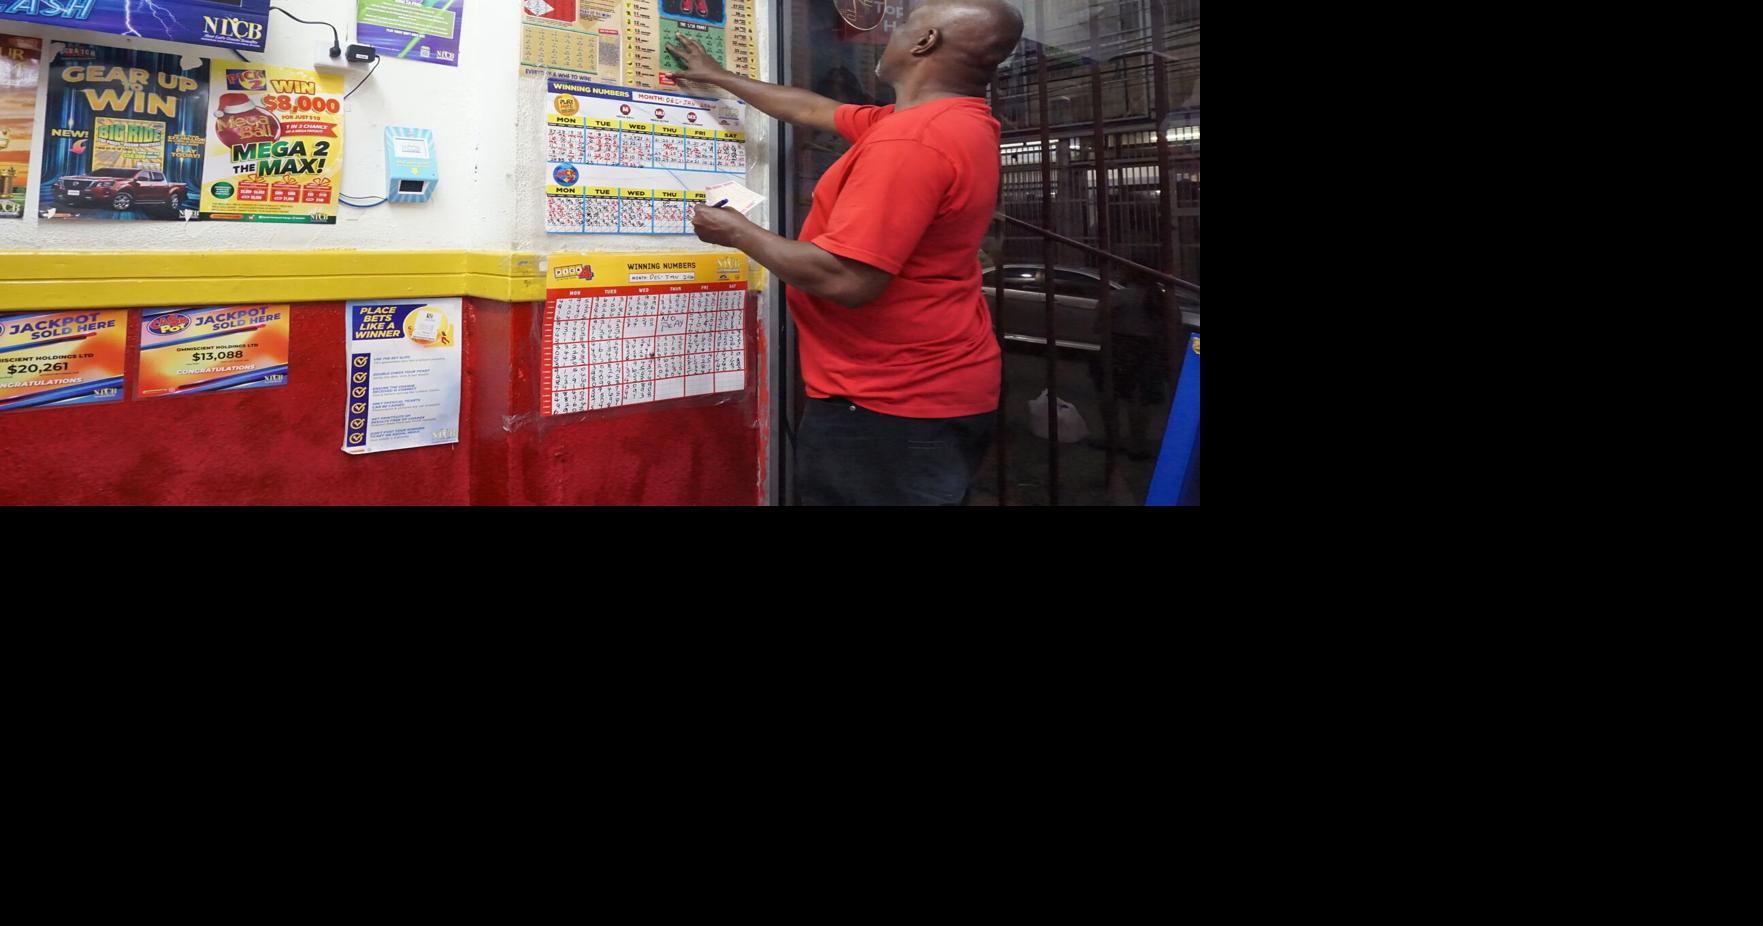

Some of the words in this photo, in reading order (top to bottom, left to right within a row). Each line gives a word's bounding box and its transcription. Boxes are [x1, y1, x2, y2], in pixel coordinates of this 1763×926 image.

[62, 65, 149, 85] GEAR
[158, 72, 198, 92] UP
[270, 80, 316, 95] WIN
[553, 83, 592, 93] WINNING
[592, 88, 630, 98] NUMBERS
[83, 88, 177, 118] WIN
[262, 94, 340, 114] $8,000
[52, 128, 89, 138] NEW!
[98, 124, 125, 142] BIG
[233, 141, 307, 162] MEGA
[314, 141, 330, 156] 2
[233, 164, 256, 174] THE
[259, 158, 326, 176] MAX!
[578, 265, 594, 280] 4
[195, 306, 269, 326] JACKPOT
[360, 306, 397, 314] PLACE
[10, 314, 97, 335] JACKPOT
[212, 320, 247, 331] SOLD
[250, 312, 281, 324] HERE
[363, 314, 392, 323] BETS
[31, 327, 72, 340] SOLD
[77, 320, 116, 332] HERE
[355, 330, 401, 338] WINNER
[360, 323, 384, 331] LIKE
[192, 350, 243, 362] $13,088
[7, 362, 68, 375] $20,261
[176, 364, 256, 375] CONGRATULATIONS
[0, 378, 82, 388] NGRATULATIONS
